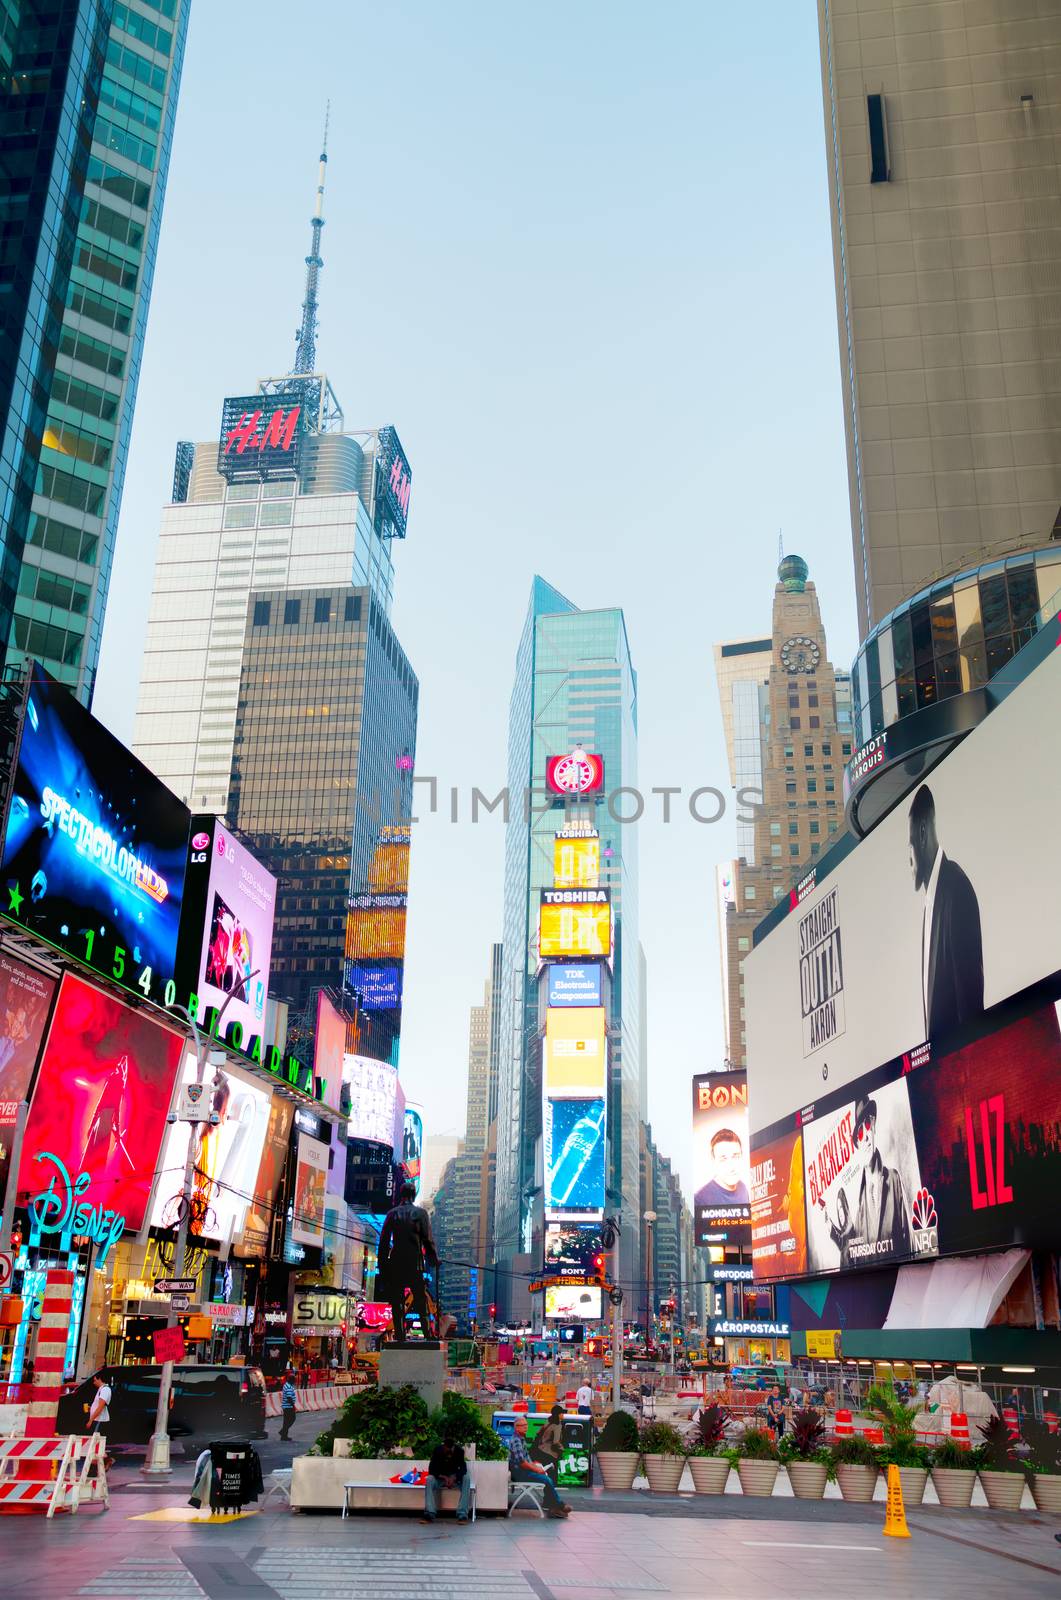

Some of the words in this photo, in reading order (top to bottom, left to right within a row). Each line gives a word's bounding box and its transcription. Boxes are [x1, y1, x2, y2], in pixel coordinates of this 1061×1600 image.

[224, 406, 300, 455] H&M
[851, 732, 887, 769] MARRIOTT
[852, 750, 883, 784] MARQUIS
[555, 829, 598, 838] TOSHIBA
[191, 852, 207, 863] LG
[225, 843, 235, 864] LG
[544, 891, 607, 903] TOSHIBA
[800, 890, 837, 956] STRAIGHT
[564, 970, 585, 979] TDK
[800, 931, 841, 1015] OUTTA
[554, 980, 595, 989] Electronic
[550, 991, 599, 1001] Components
[810, 999, 837, 1050] AKRON
[0, 1101, 17, 1116] VER
[808, 1109, 855, 1206] BLACKLIST
[965, 1094, 1013, 1210] LIZ
[385, 1165, 393, 1197] 1500
[701, 1208, 742, 1219] MONDAYS
[742, 1208, 749, 1217] &
[848, 1243, 876, 1258] THURSDAY
[876, 1239, 889, 1254] OCT
[889, 1238, 894, 1251] 1
[914, 1230, 938, 1252] NBC
[159, 1281, 172, 1290] ONE
[179, 1281, 193, 1289] WAY
[714, 1320, 789, 1334] AÉROPOSTALE
